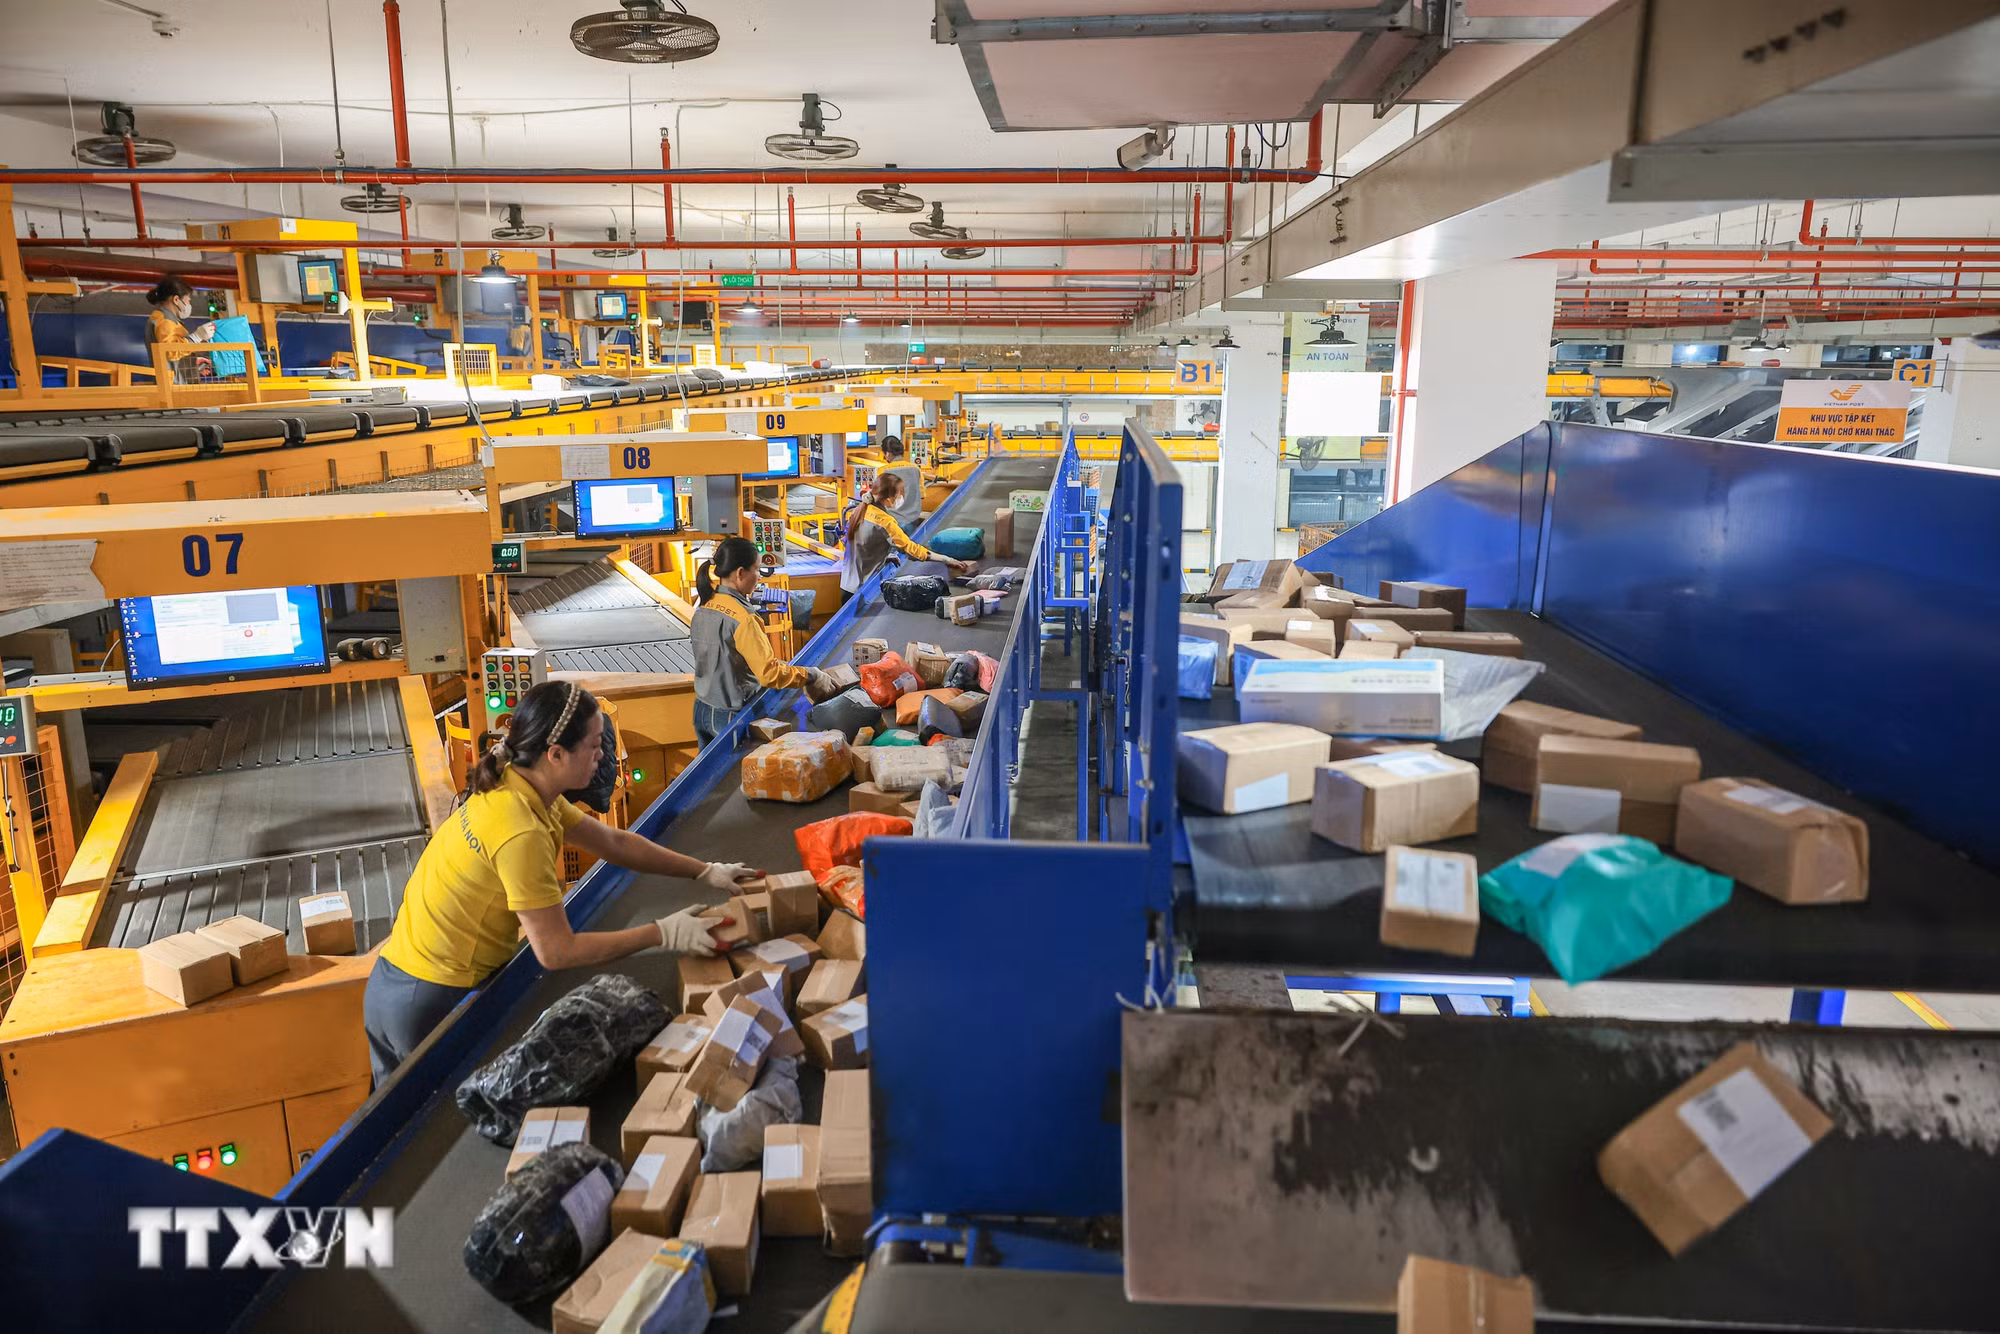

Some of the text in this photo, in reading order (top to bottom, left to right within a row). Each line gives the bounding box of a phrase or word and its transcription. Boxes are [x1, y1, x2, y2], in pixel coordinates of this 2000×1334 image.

[221, 225, 230, 240] 21
[434, 254, 443, 266] 22
[1306, 352, 1320, 361] AN
[1181, 363, 1211, 382] B1
[1900, 363, 1930, 384] C1
[766, 414, 785, 430] 09
[1810, 414, 1826, 423] KHU
[1855, 427, 1873, 436] KHAI
[623, 446, 650, 470] 08
[182, 533, 243, 577] 07
